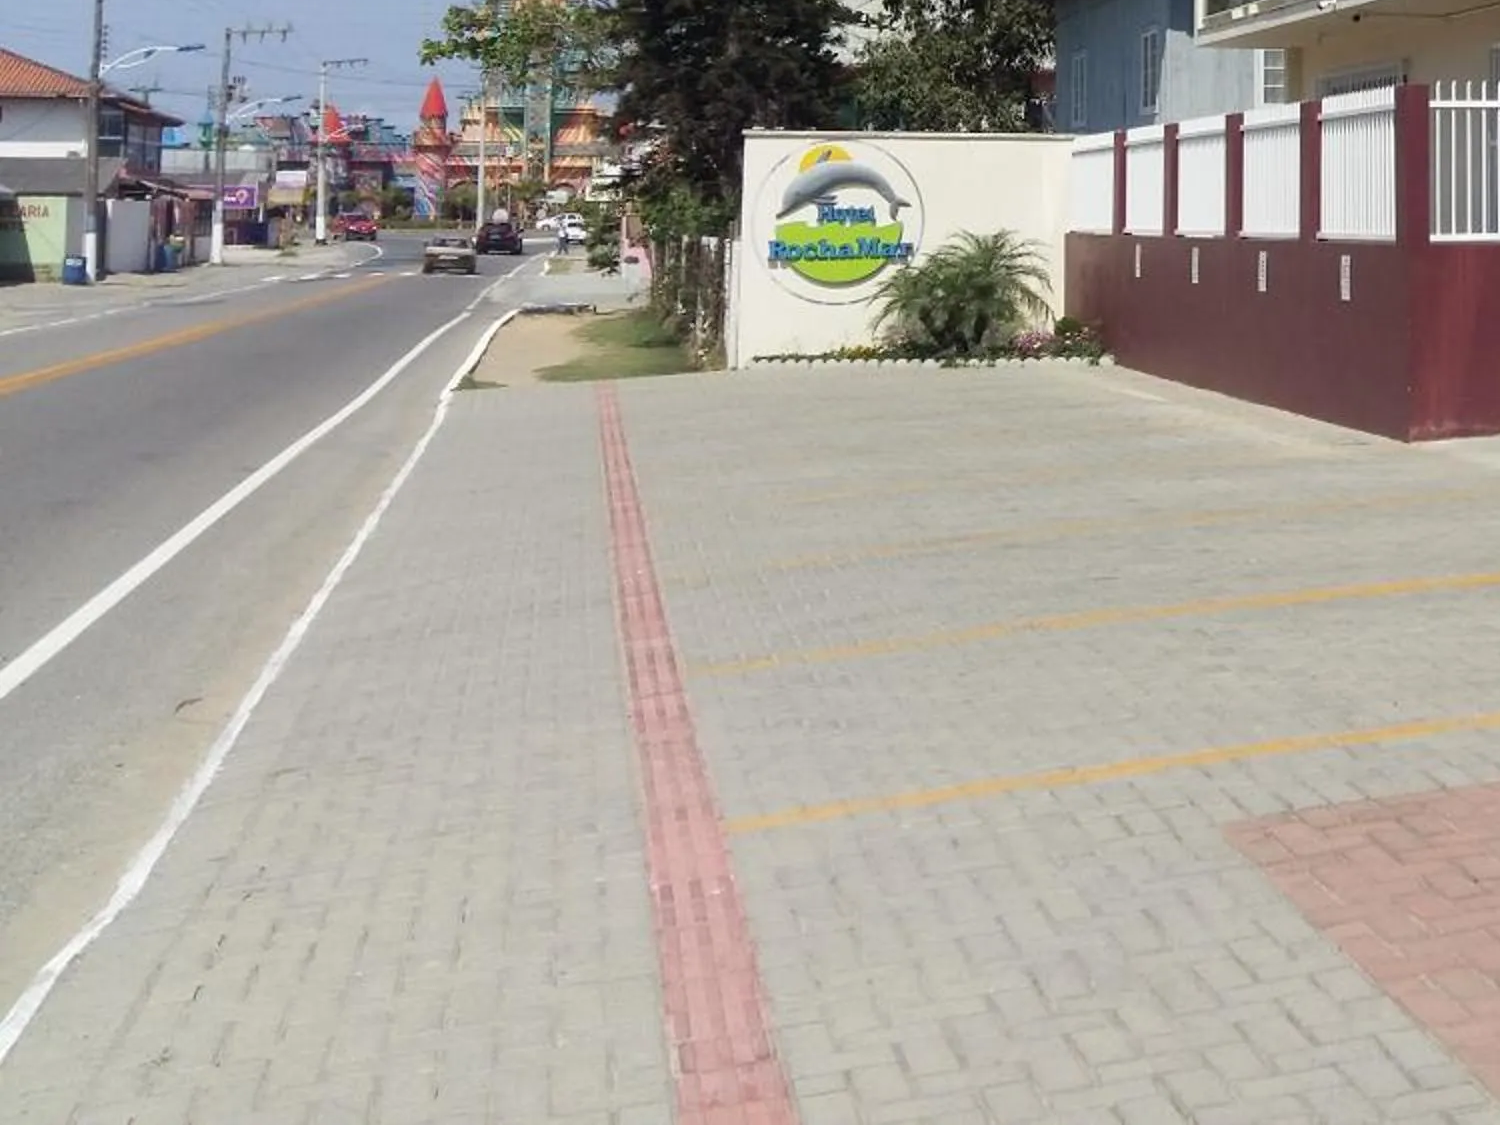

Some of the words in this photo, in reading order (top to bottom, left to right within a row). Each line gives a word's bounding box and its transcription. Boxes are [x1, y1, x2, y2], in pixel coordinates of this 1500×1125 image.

[817, 203, 875, 223] Hotel
[768, 238, 853, 261] Rocha
[856, 236, 914, 261] Mar
